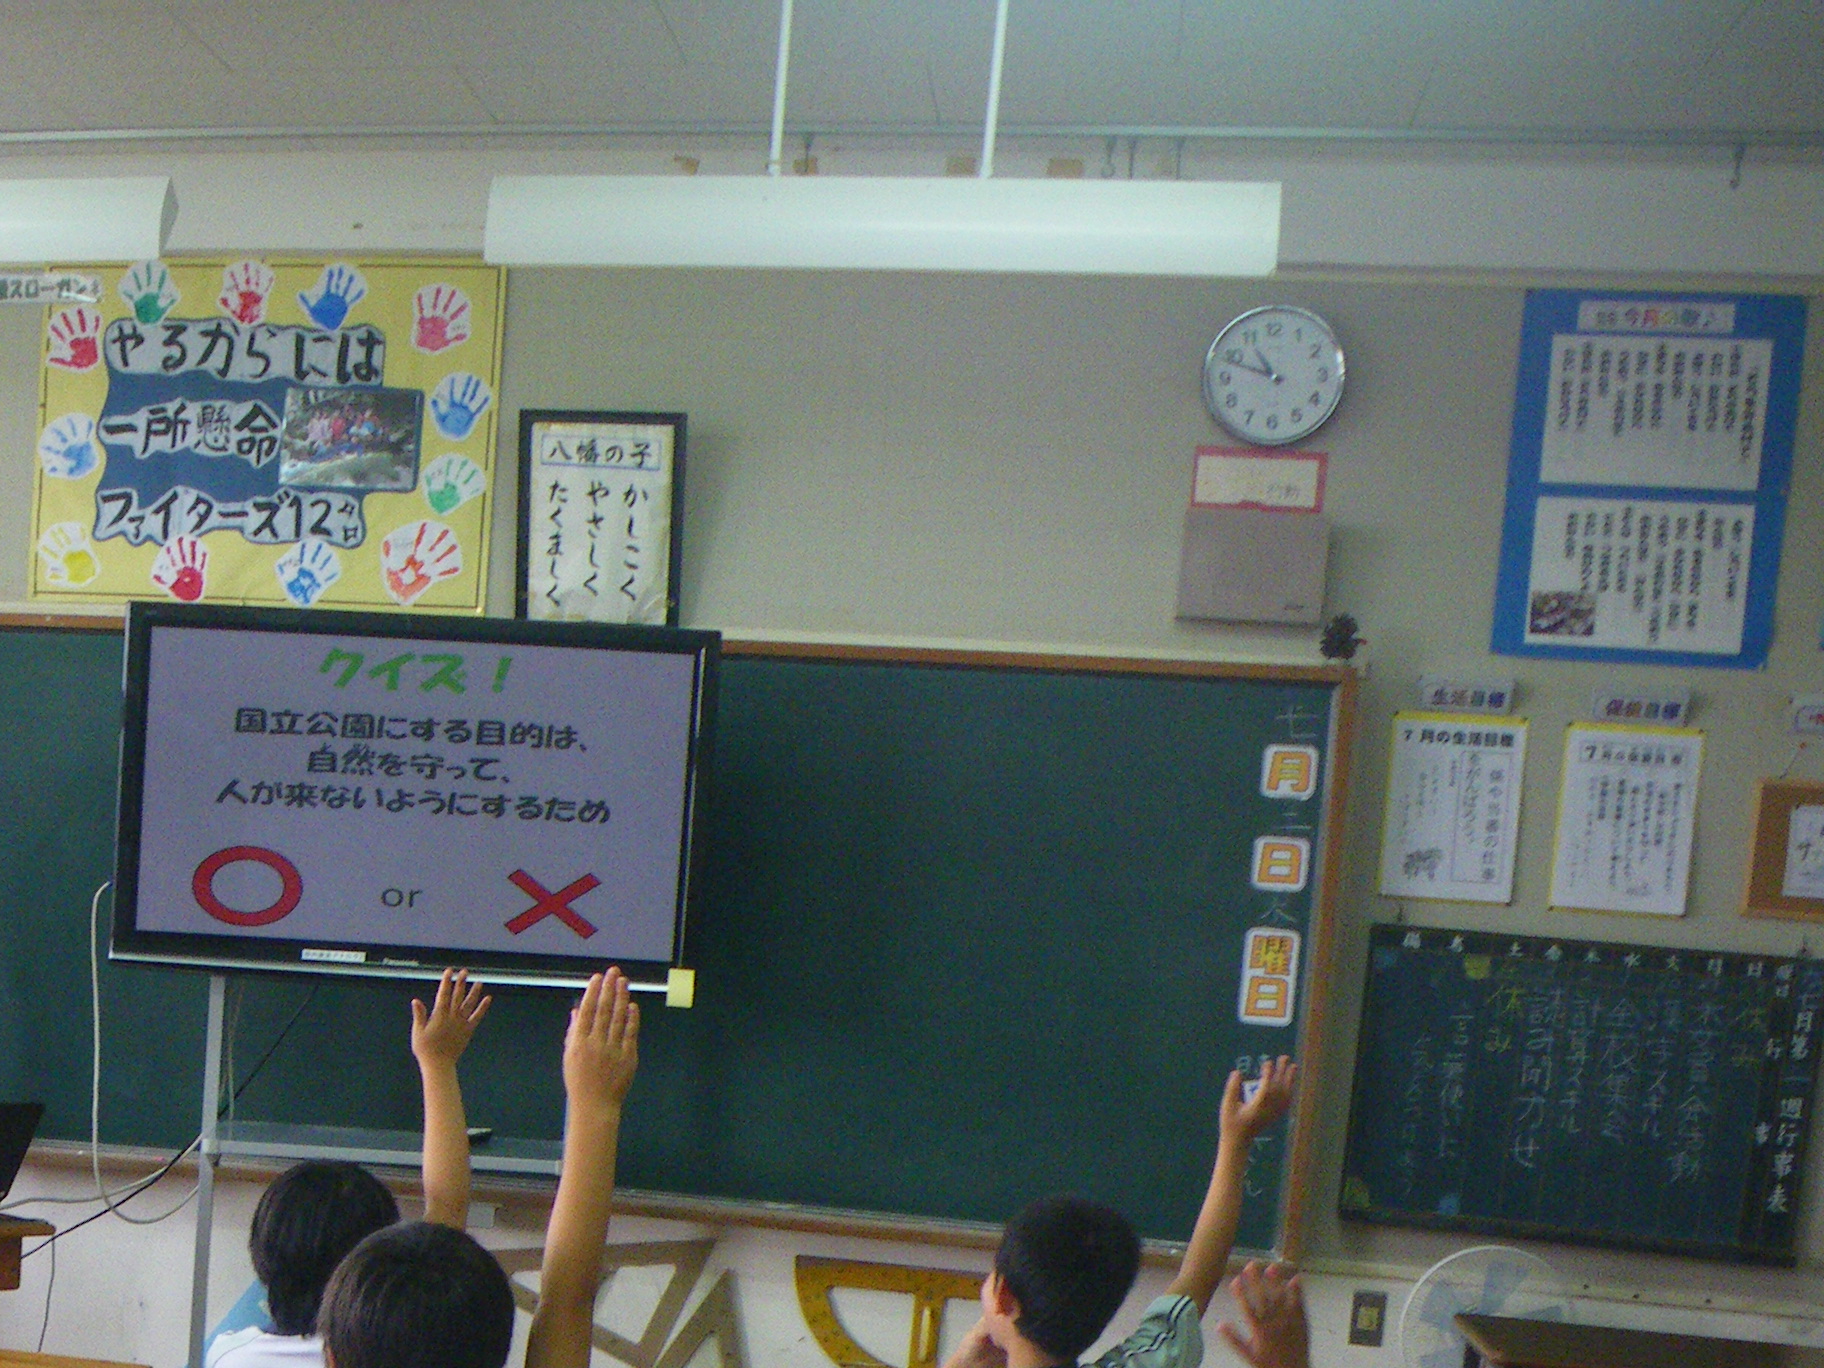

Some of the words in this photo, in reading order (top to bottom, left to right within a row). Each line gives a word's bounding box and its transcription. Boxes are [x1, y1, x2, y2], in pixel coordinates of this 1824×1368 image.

[112, 325, 383, 384] やるからには
[103, 402, 281, 466] 一所懸命
[549, 438, 652, 470] 八幡の子
[546, 480, 570, 607] たくましく
[583, 480, 611, 598] やさしく
[619, 483, 650, 602] かしこく
[234, 706, 590, 752] 国立公園にする目的は、
[307, 743, 511, 785] 自然を守って、
[216, 778, 612, 825] 人が来ないようにするため
[380, 886, 423, 909] or
